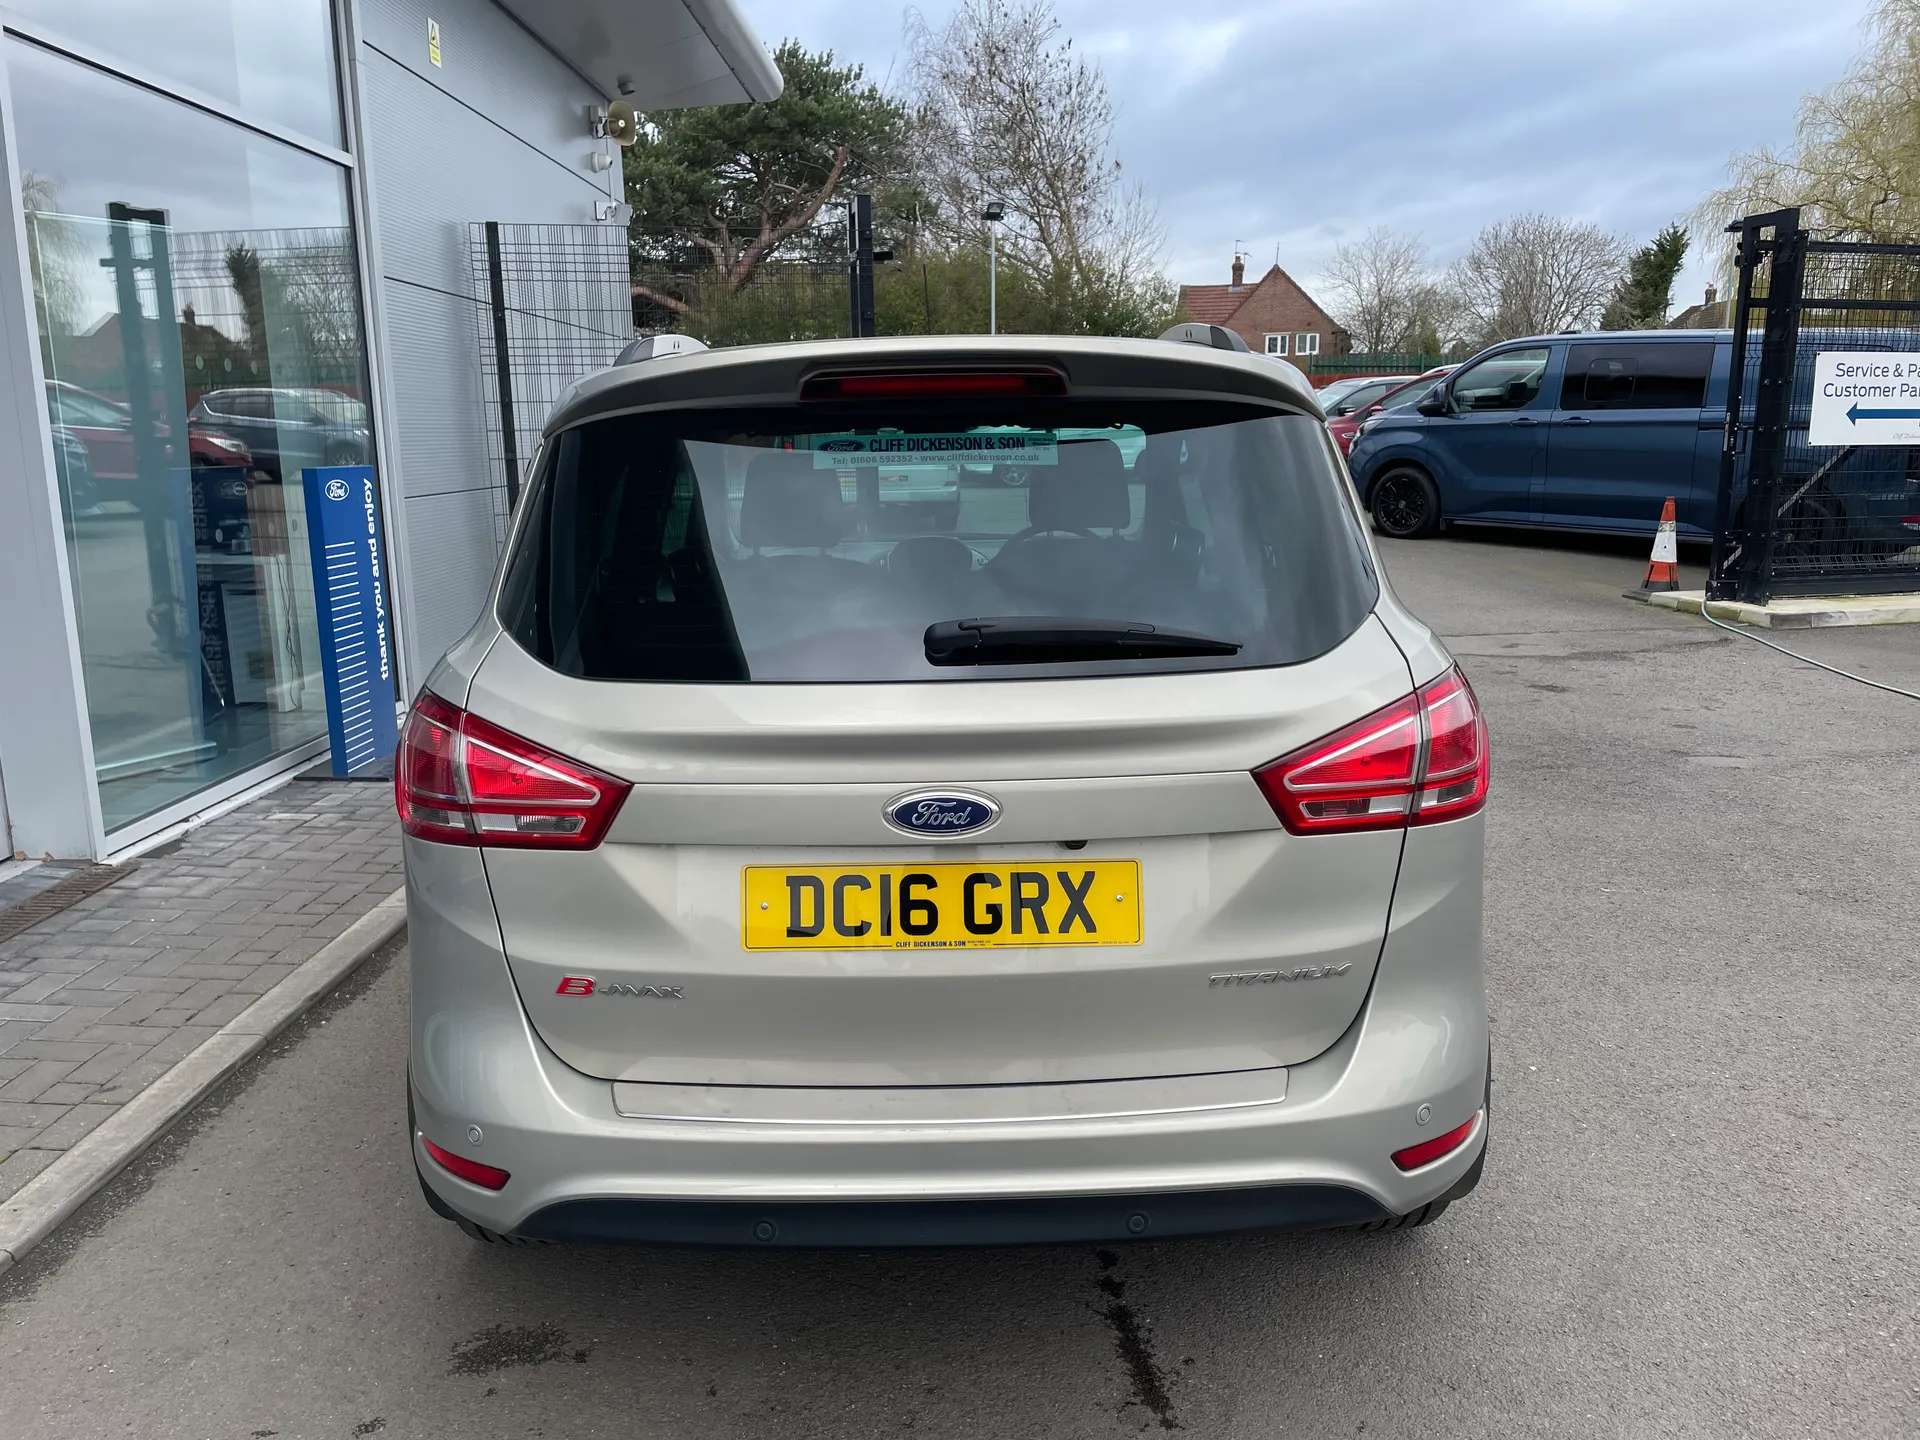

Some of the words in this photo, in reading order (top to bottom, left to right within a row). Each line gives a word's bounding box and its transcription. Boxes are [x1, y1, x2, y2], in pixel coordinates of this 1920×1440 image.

[1835, 363, 1889, 378] Service
[1893, 364, 1904, 378] &
[1823, 383, 1897, 398] Customer
[870, 439, 905, 452] CLIFF
[907, 437, 979, 452] DICKENSON
[985, 437, 995, 450] &
[999, 436, 1026, 449] SON
[363, 477, 376, 535] enjoy
[367, 538, 380, 578] and
[373, 581, 385, 622] you
[376, 622, 389, 681] thank
[911, 800, 972, 826] Ford
[786, 873, 939, 938] DC16
[963, 870, 1097, 936] GRX
[895, 940, 911, 948] CLIFF
[913, 940, 947, 948] DICKENSON
[555, 975, 683, 999] B-MAX
[1209, 961, 1352, 988] TITANIUM
